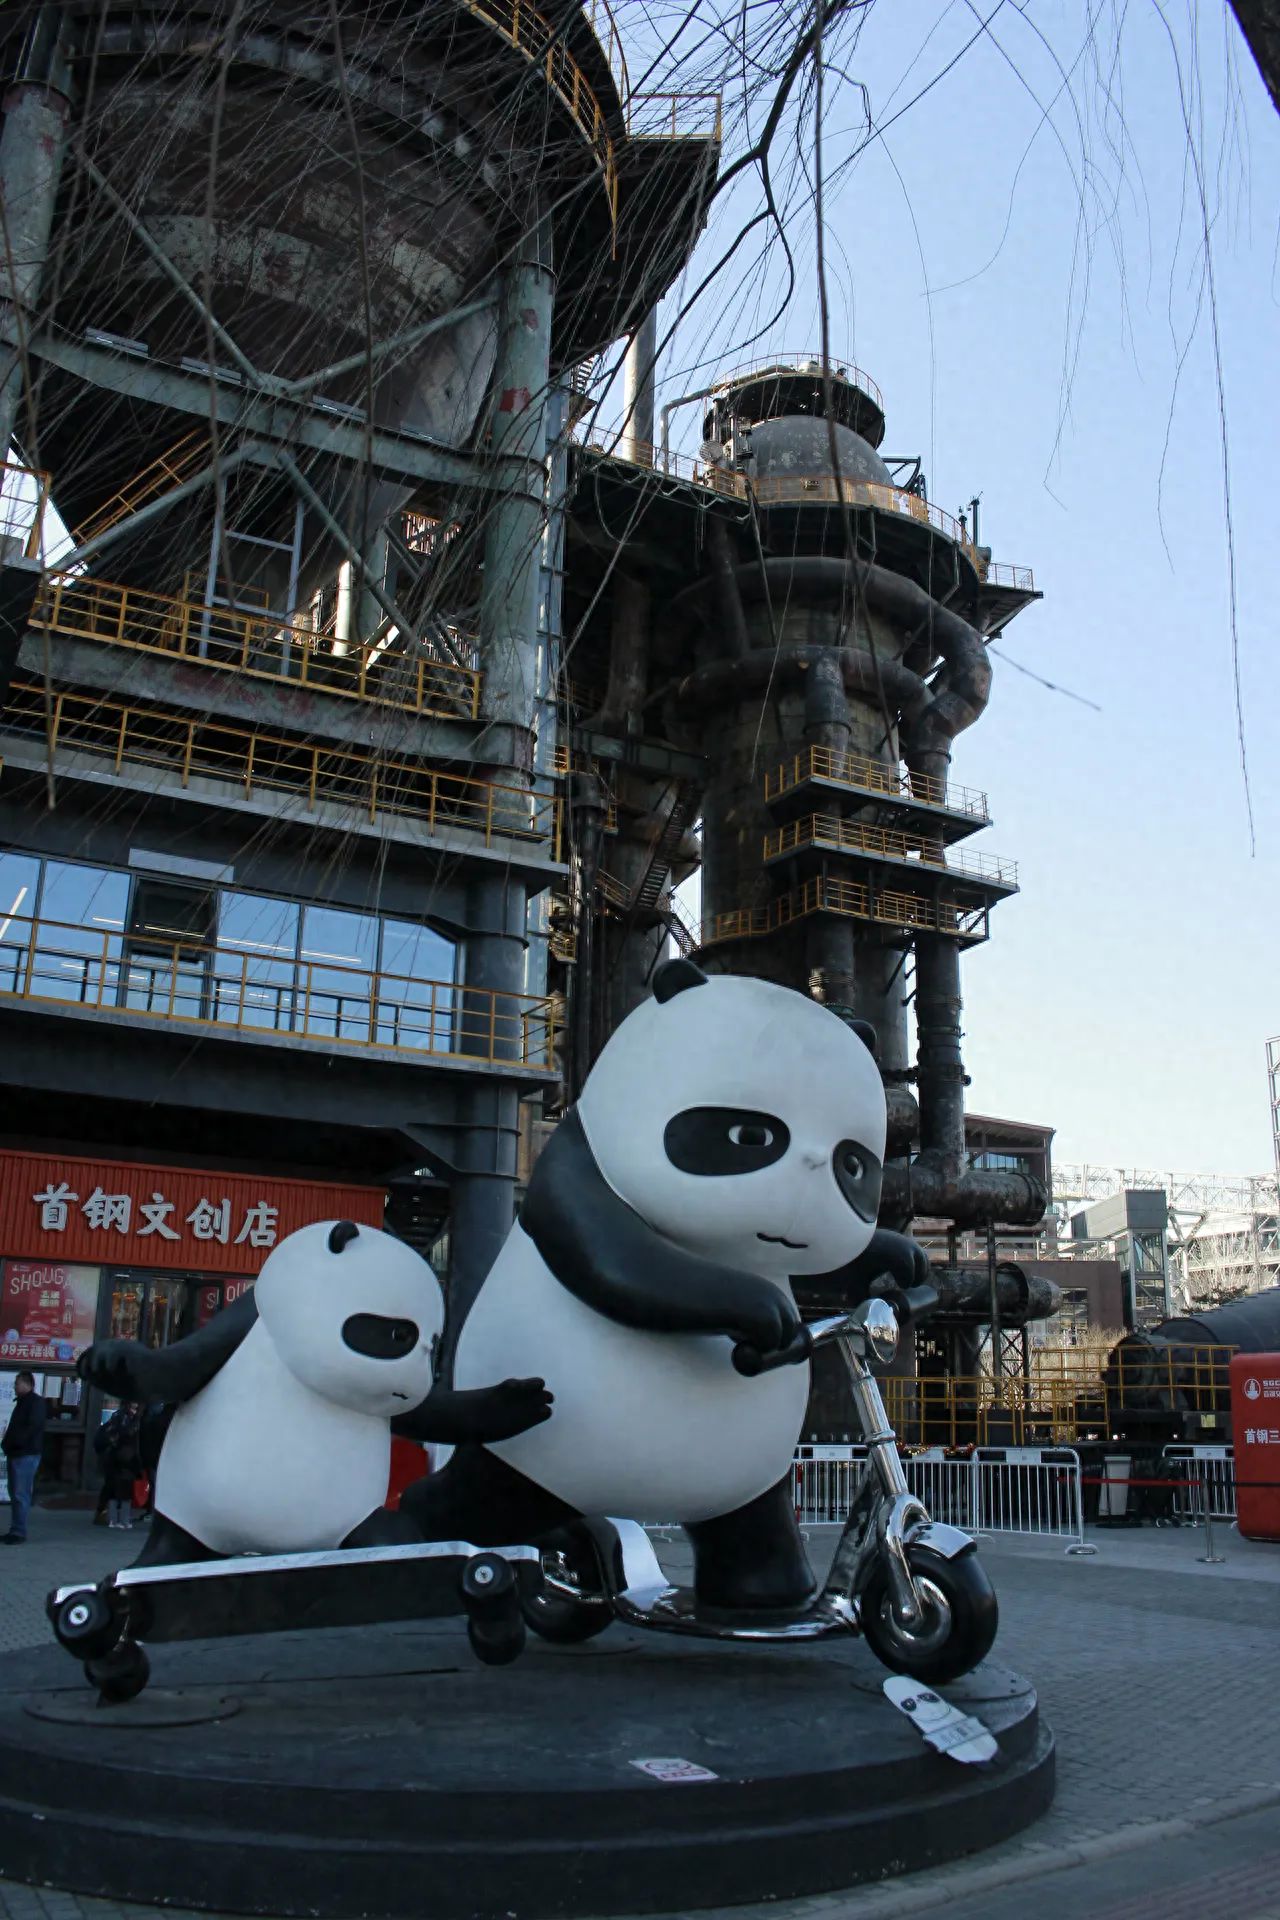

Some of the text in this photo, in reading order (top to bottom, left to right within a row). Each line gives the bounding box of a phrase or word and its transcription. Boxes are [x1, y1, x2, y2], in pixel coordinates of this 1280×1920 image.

[33, 1182, 279, 1248] 首钢文创店
